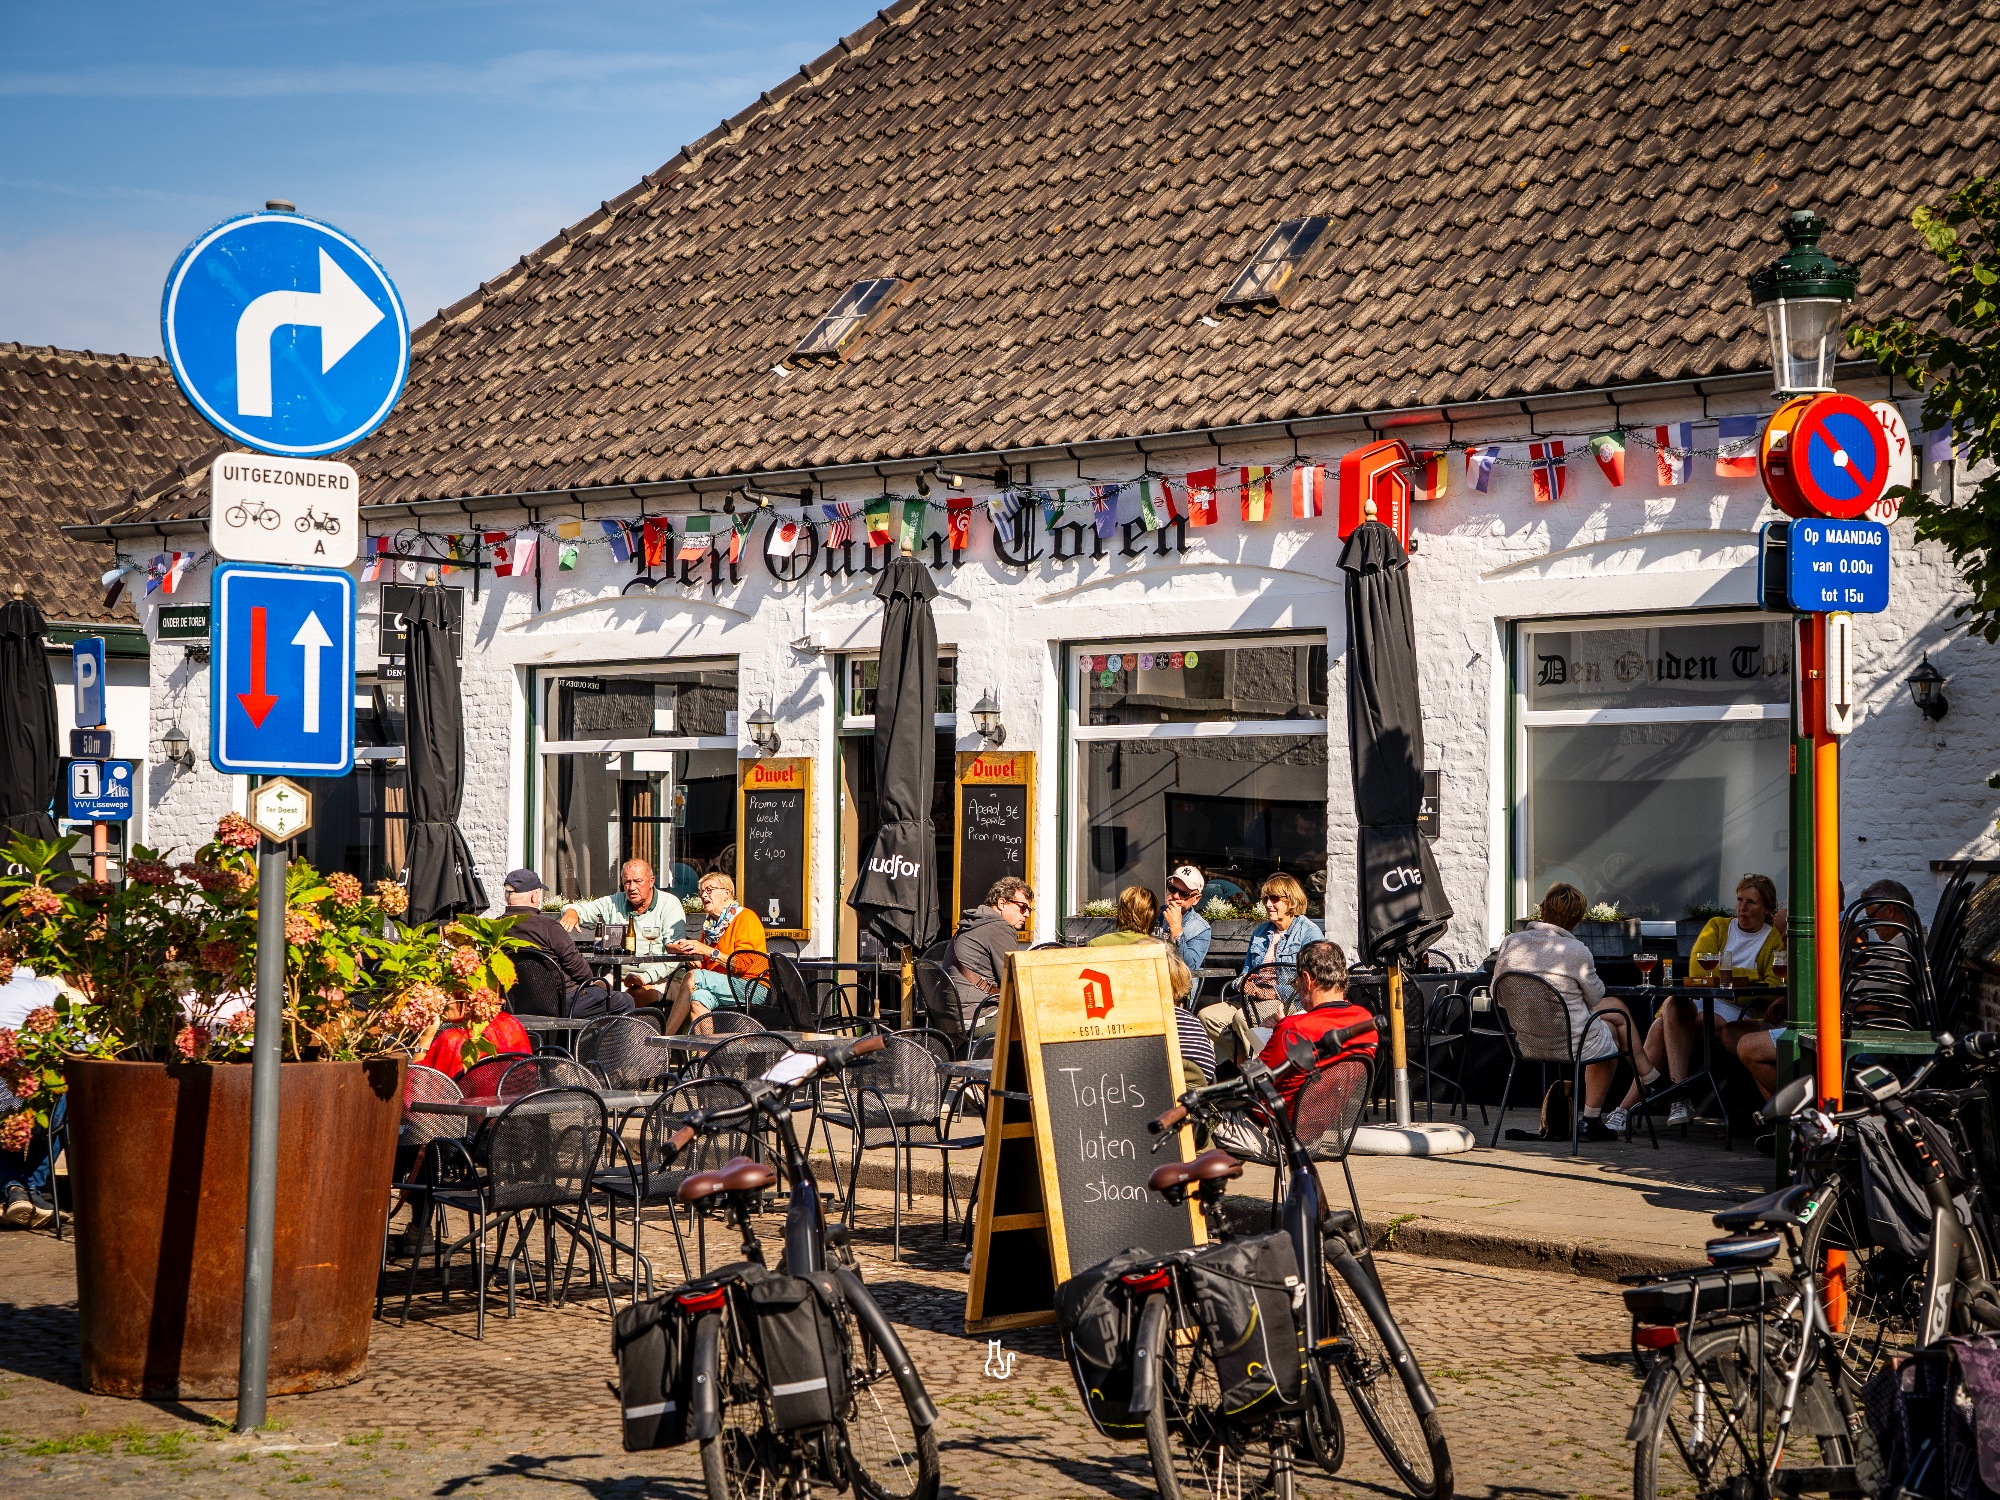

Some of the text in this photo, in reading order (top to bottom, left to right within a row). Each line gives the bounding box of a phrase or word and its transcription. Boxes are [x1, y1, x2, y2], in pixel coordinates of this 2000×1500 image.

[1874, 410, 1906, 457] LLA
[224, 465, 349, 490] UITGEZONDERD
[1804, 527, 1882, 546] Op MAANDAG
[314, 539, 326, 555] A
[1812, 558, 1873, 574] van 0.00u
[1821, 587, 1864, 603] tot 15u
[162, 615, 206, 628] ONDER DE TOREN
[1537, 653, 1602, 687] Den
[1614, 650, 1718, 684] Ouden
[77, 653, 97, 714] P
[83, 734, 101, 754] 50m
[755, 764, 793, 783] Duvel
[974, 757, 1015, 777] Duvel
[74, 800, 129, 810] VVV Lissewege
[749, 795, 778, 810] Promo
[756, 810, 780, 823] week
[1079, 1024, 1127, 1037] ESTD. 1871
[1058, 1067, 1146, 1126] Tafels
[1079, 1127, 1136, 1163] laten
